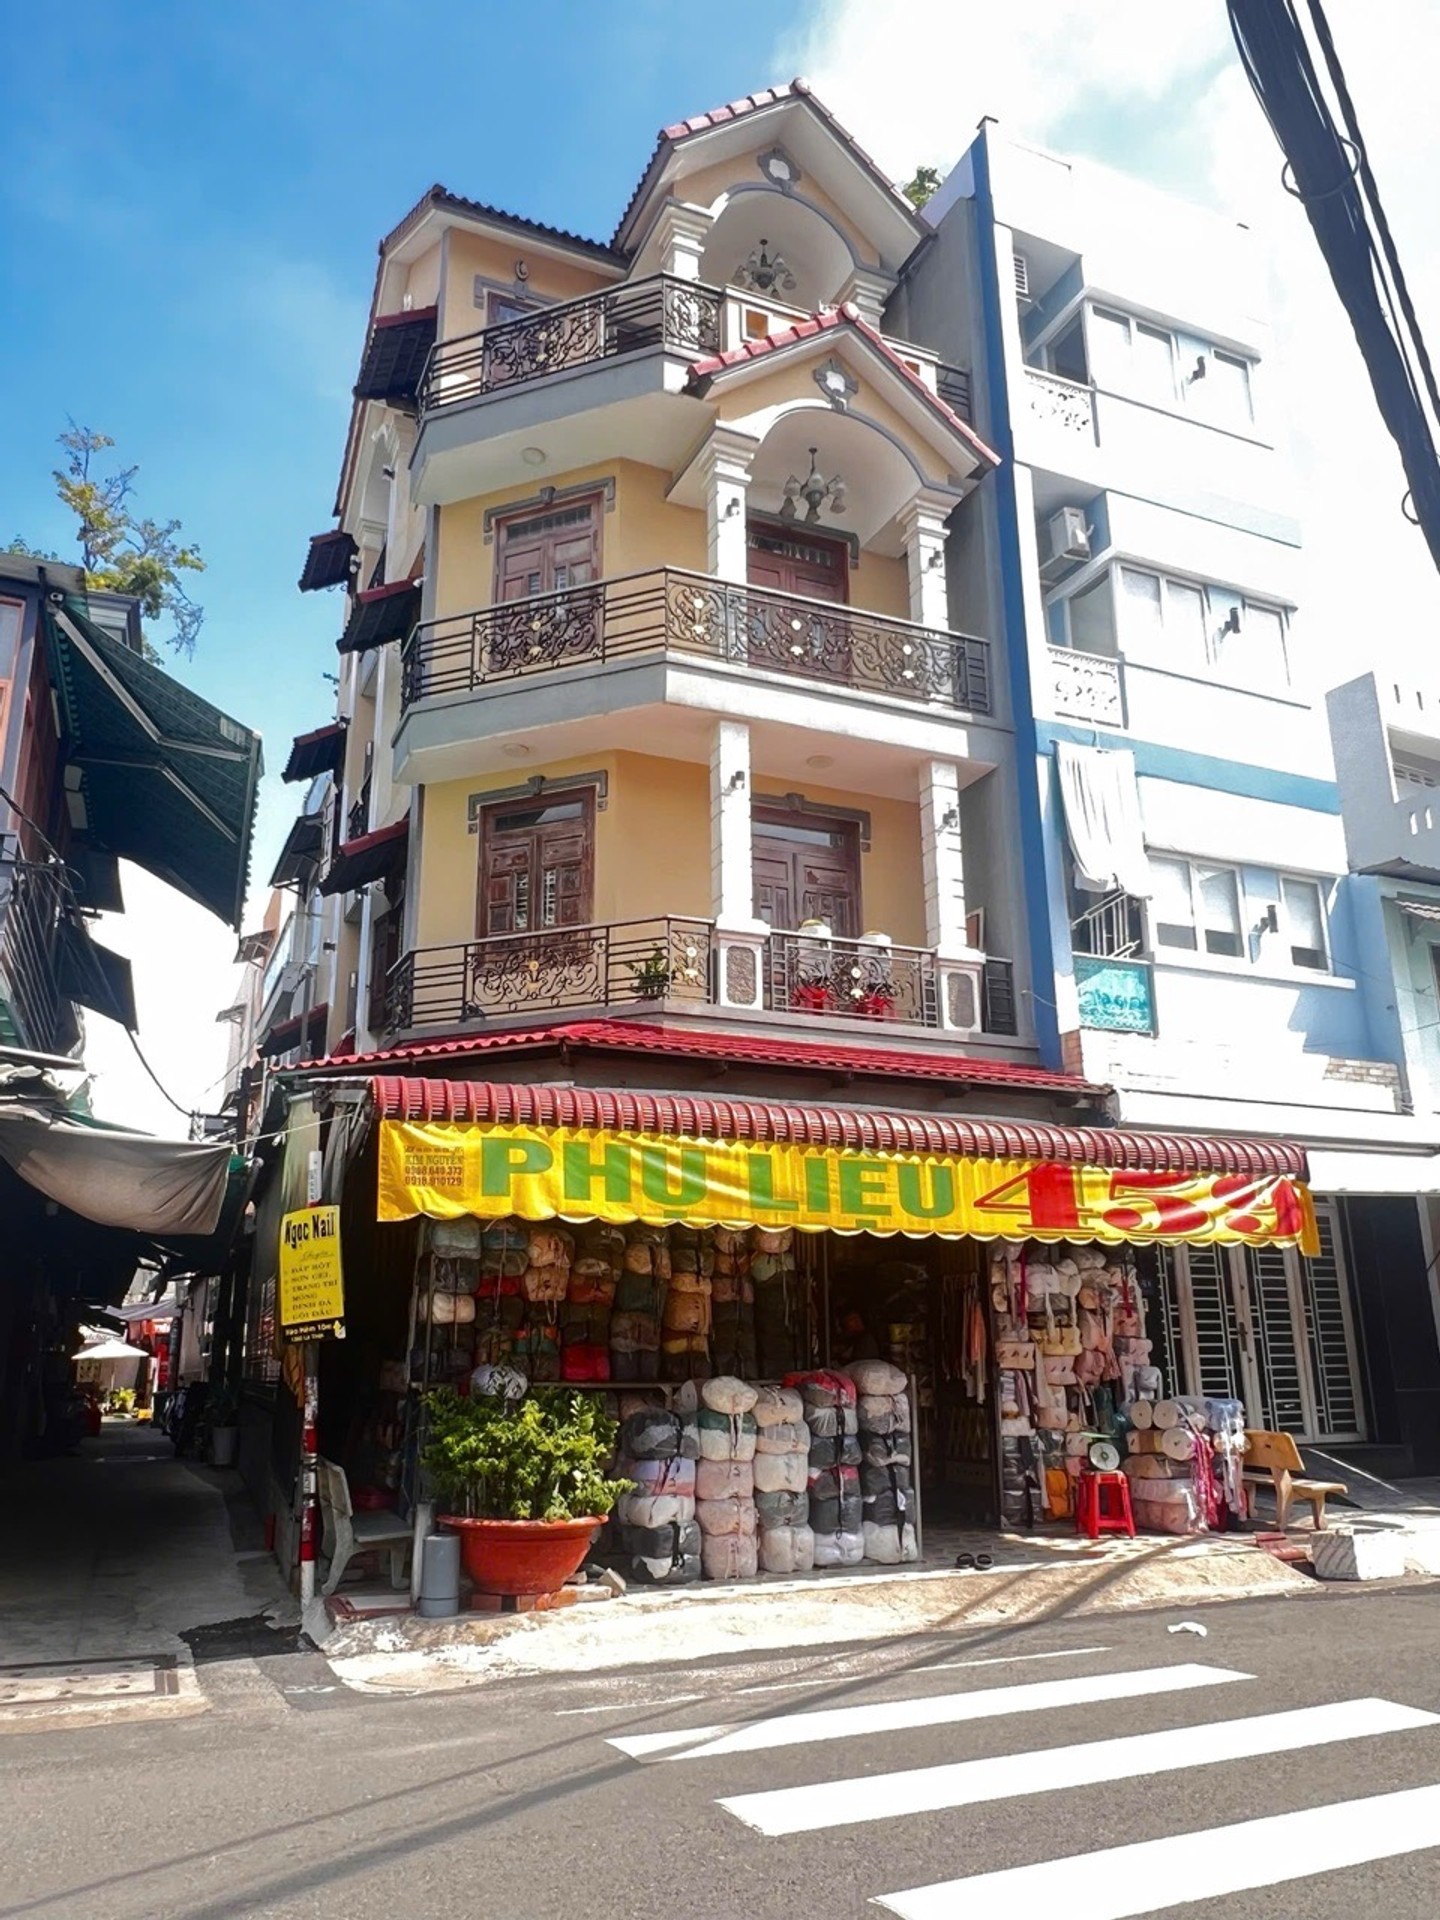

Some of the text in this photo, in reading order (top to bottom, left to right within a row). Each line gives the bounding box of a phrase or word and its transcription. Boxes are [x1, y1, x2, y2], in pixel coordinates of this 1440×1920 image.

[405, 1155, 424, 1165] KIM
[481, 1137, 708, 1218] PHỤ
[312, 1212, 335, 1239] Nail
